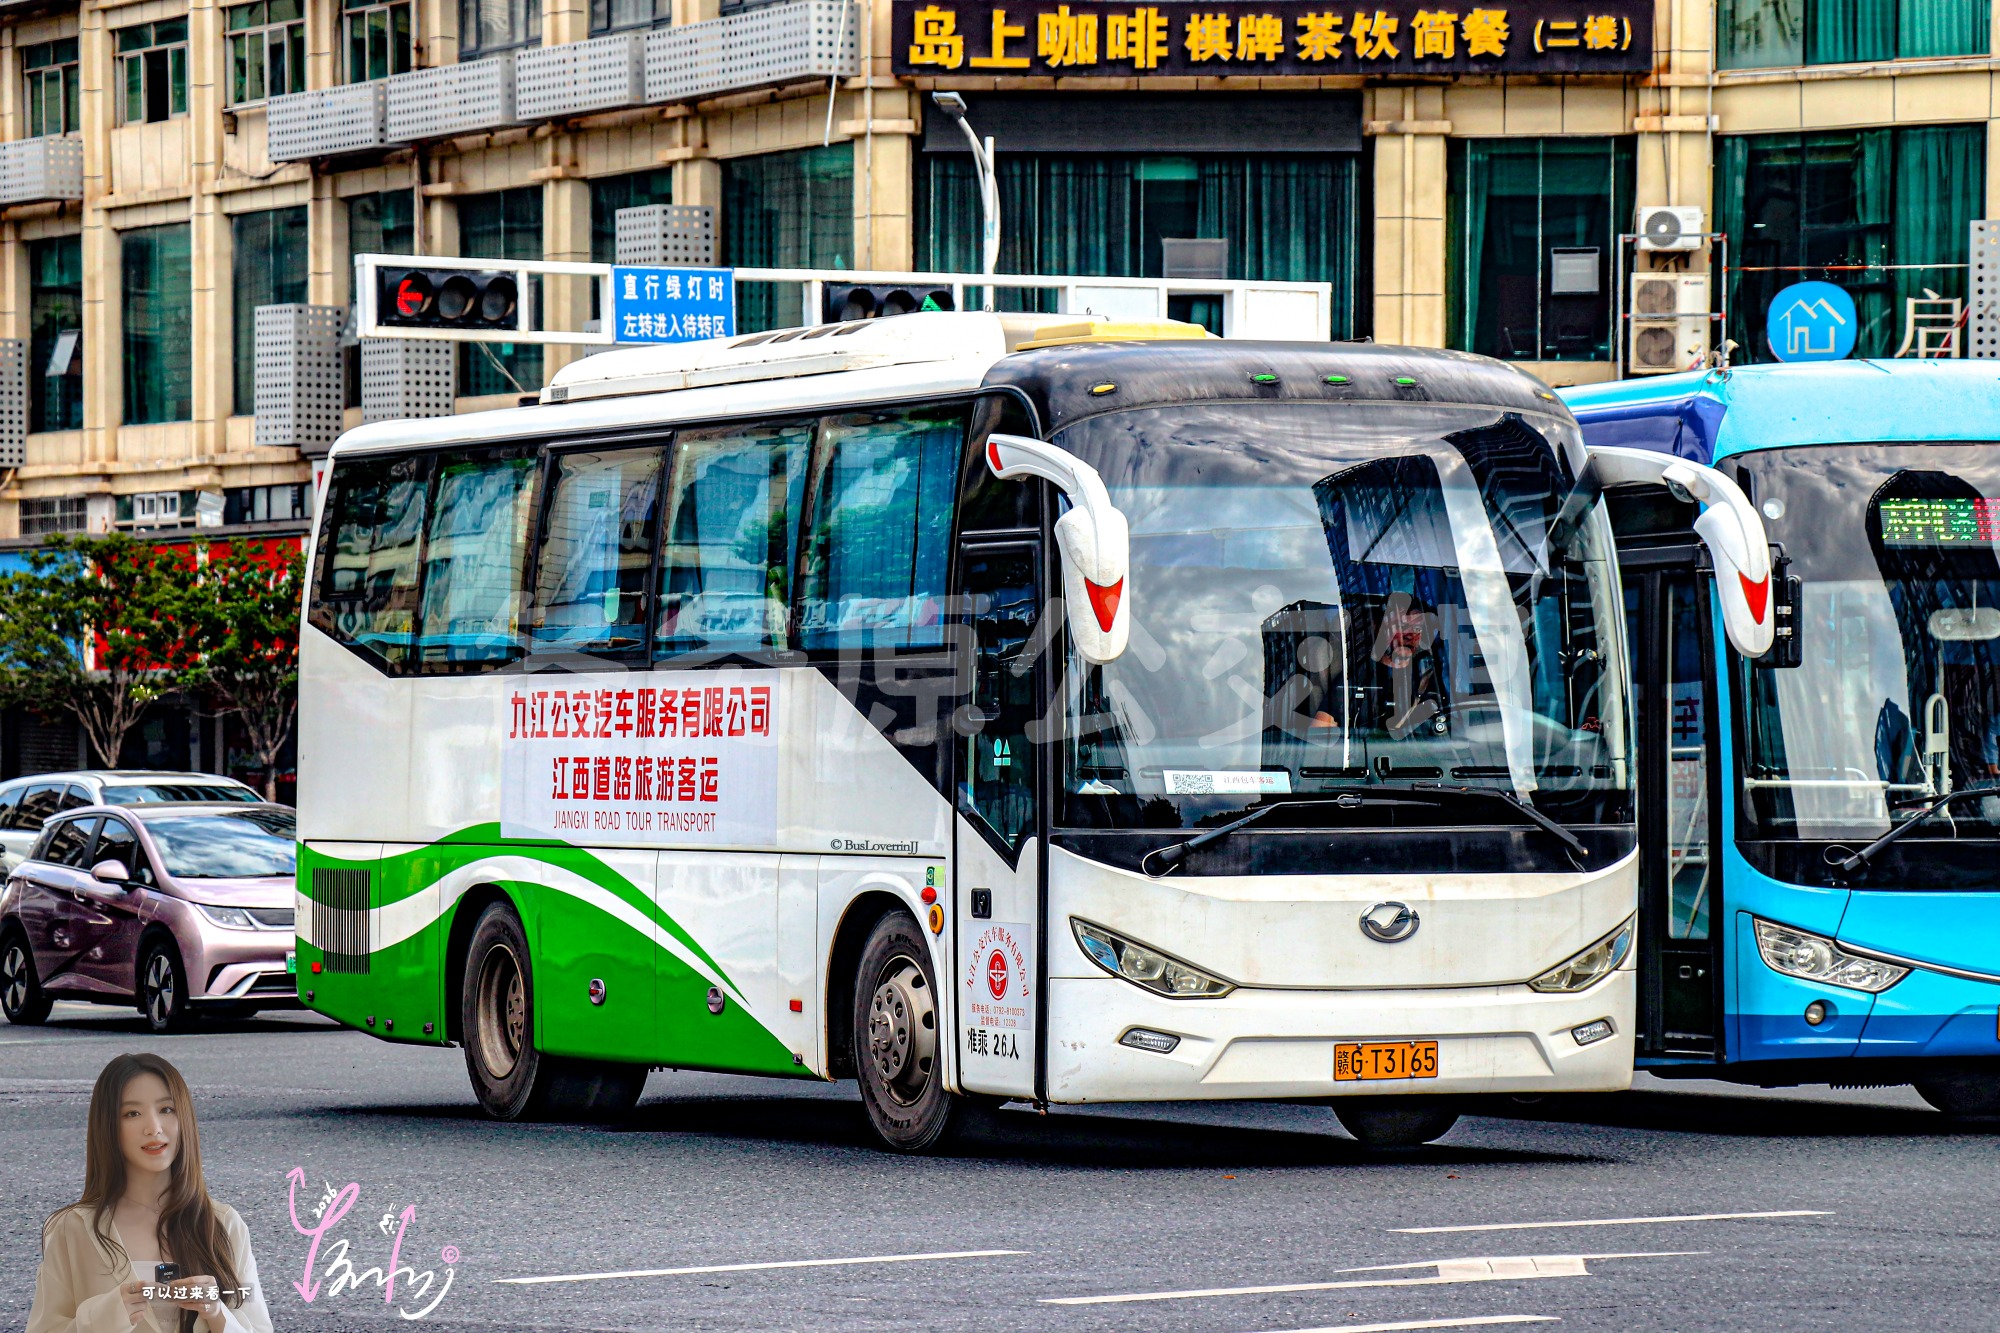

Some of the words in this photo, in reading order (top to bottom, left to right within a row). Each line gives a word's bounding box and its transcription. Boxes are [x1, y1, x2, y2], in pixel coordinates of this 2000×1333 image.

[909, 5, 1169, 69] 岛上咖啡
[1533, 15, 1633, 52] （二楼）
[623, 273, 724, 301] 直行绿灯时
[623, 312, 726, 338] 左转进入待转区
[510, 686, 771, 739] 九江公交汽车服务有限公司
[551, 755, 719, 803] 江西道路旅游客运
[553, 811, 589, 829] JIANGXI
[594, 811, 621, 830] ROAD
[626, 812, 652, 831] TOUR
[658, 812, 717, 833] TRANSPORT
[967, 1027, 988, 1057] 准乘
